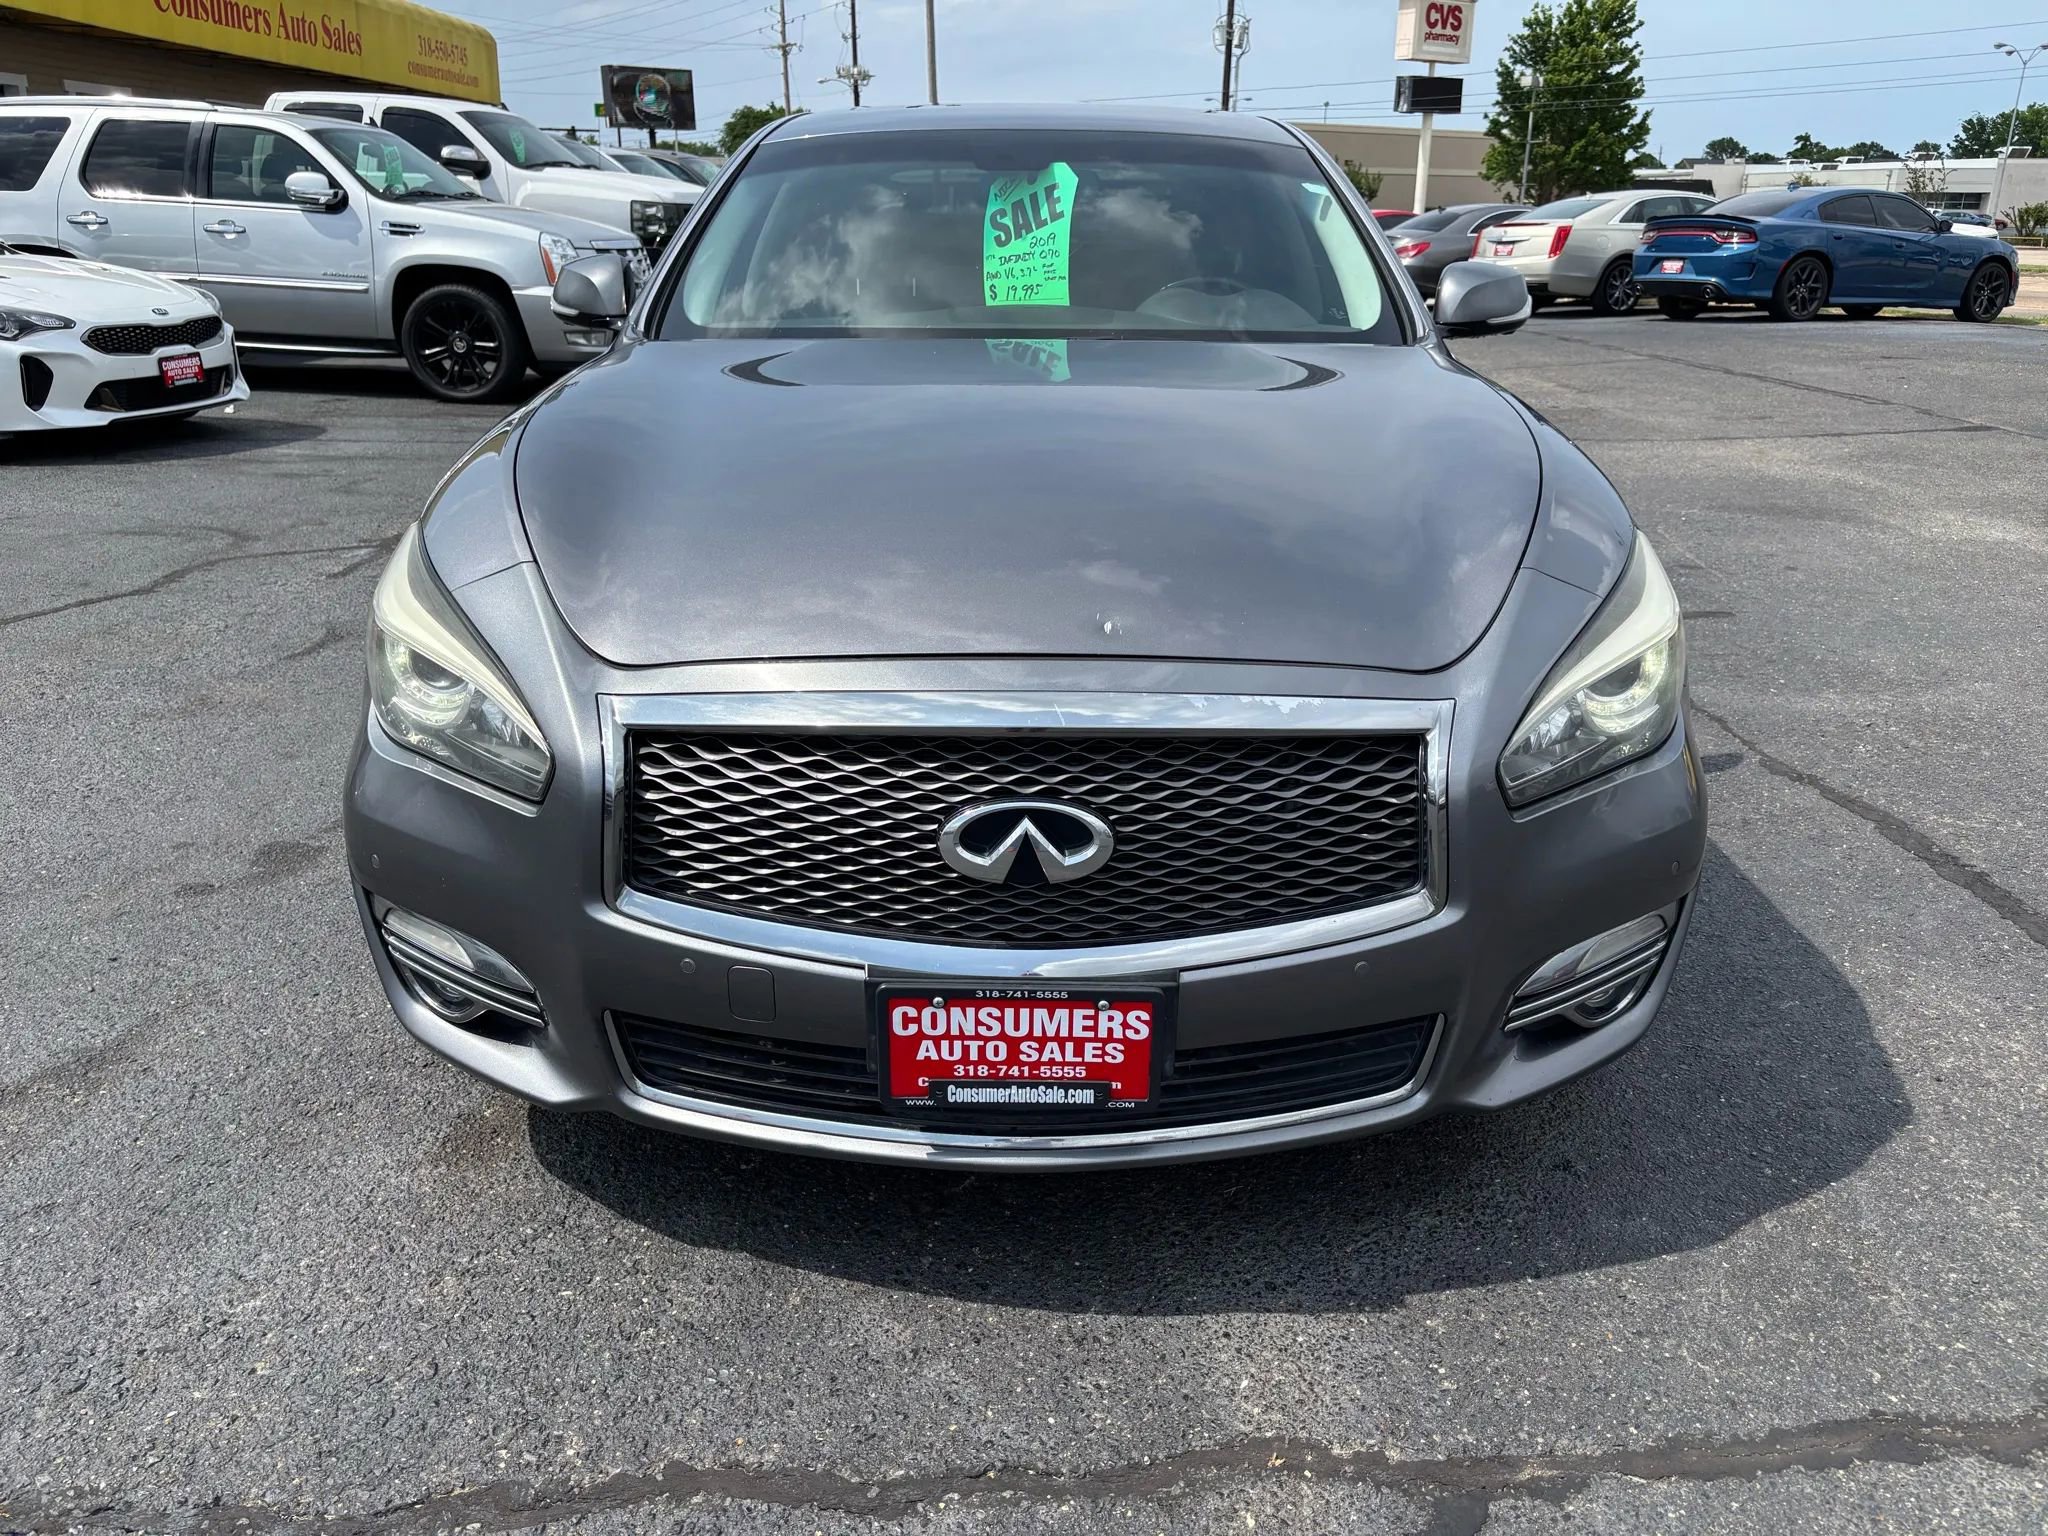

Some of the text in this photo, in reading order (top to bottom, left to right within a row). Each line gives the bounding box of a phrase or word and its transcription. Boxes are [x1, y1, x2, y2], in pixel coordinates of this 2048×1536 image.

[1426, 3, 1463, 32] CVS
[277, 3, 318, 47] Auto
[321, 14, 362, 56] Sales
[1424, 31, 1460, 45] pharmacy
[418, 34, 468, 67] 318-550-5745
[989, 182, 1065, 248] SALE
[1030, 232, 1056, 249] 2019
[162, 357, 201, 371] CONSUMERS
[167, 369, 182, 377] AUTO
[183, 366, 199, 374] SALES
[975, 989, 1068, 999] 318-741-5555
[892, 1006, 1150, 1040] CONSUMERS
[916, 1040, 1125, 1063] AUTO SALES
[953, 1064, 1087, 1078] 318-741-5555
[947, 1084, 1095, 1105] ConsumerAutoSale.com
